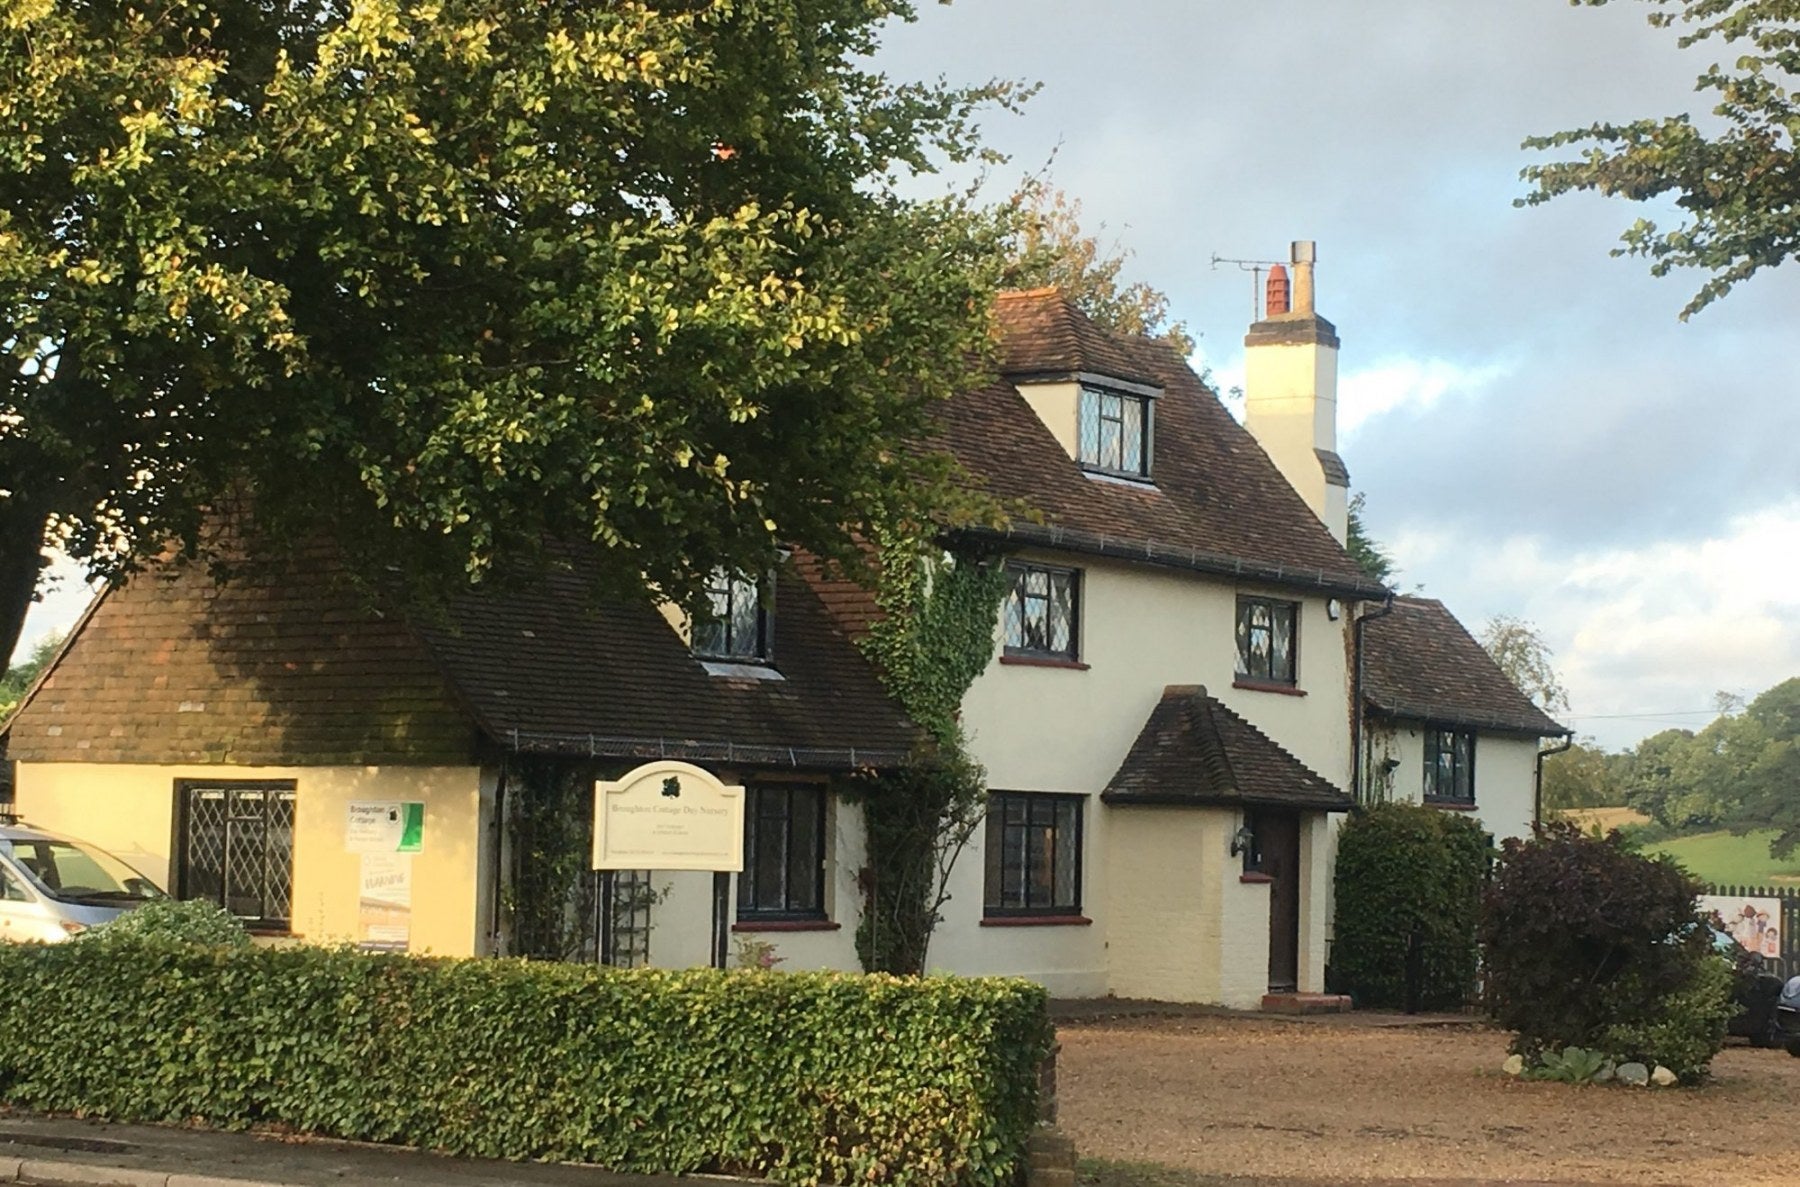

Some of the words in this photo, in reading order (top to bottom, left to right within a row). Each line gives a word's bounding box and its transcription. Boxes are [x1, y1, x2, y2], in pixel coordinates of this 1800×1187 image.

[612, 804, 651, 814] Broughton
[653, 805, 681, 815] Cottage
[683, 806, 698, 815] Day
[700, 806, 728, 816] Nursery
